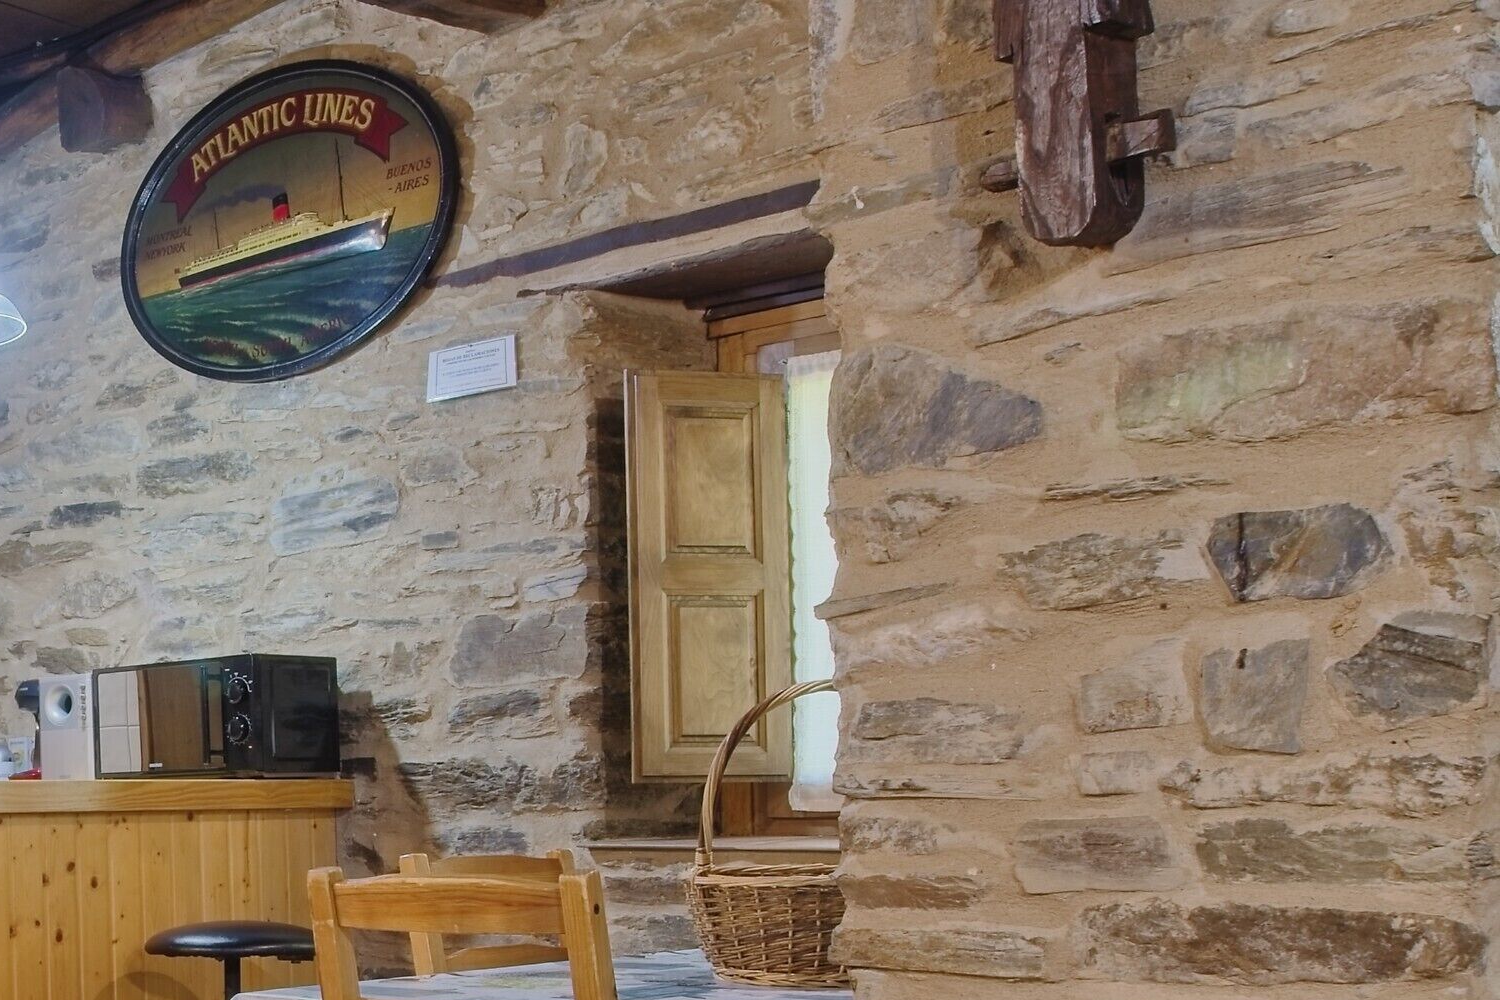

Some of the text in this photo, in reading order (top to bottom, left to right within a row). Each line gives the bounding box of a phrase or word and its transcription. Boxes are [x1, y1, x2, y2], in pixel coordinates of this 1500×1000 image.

[190, 93, 376, 183] ATLANTIC LINES
[386, 157, 432, 180] BUENOS
[251, 337, 292, 359] SOH
